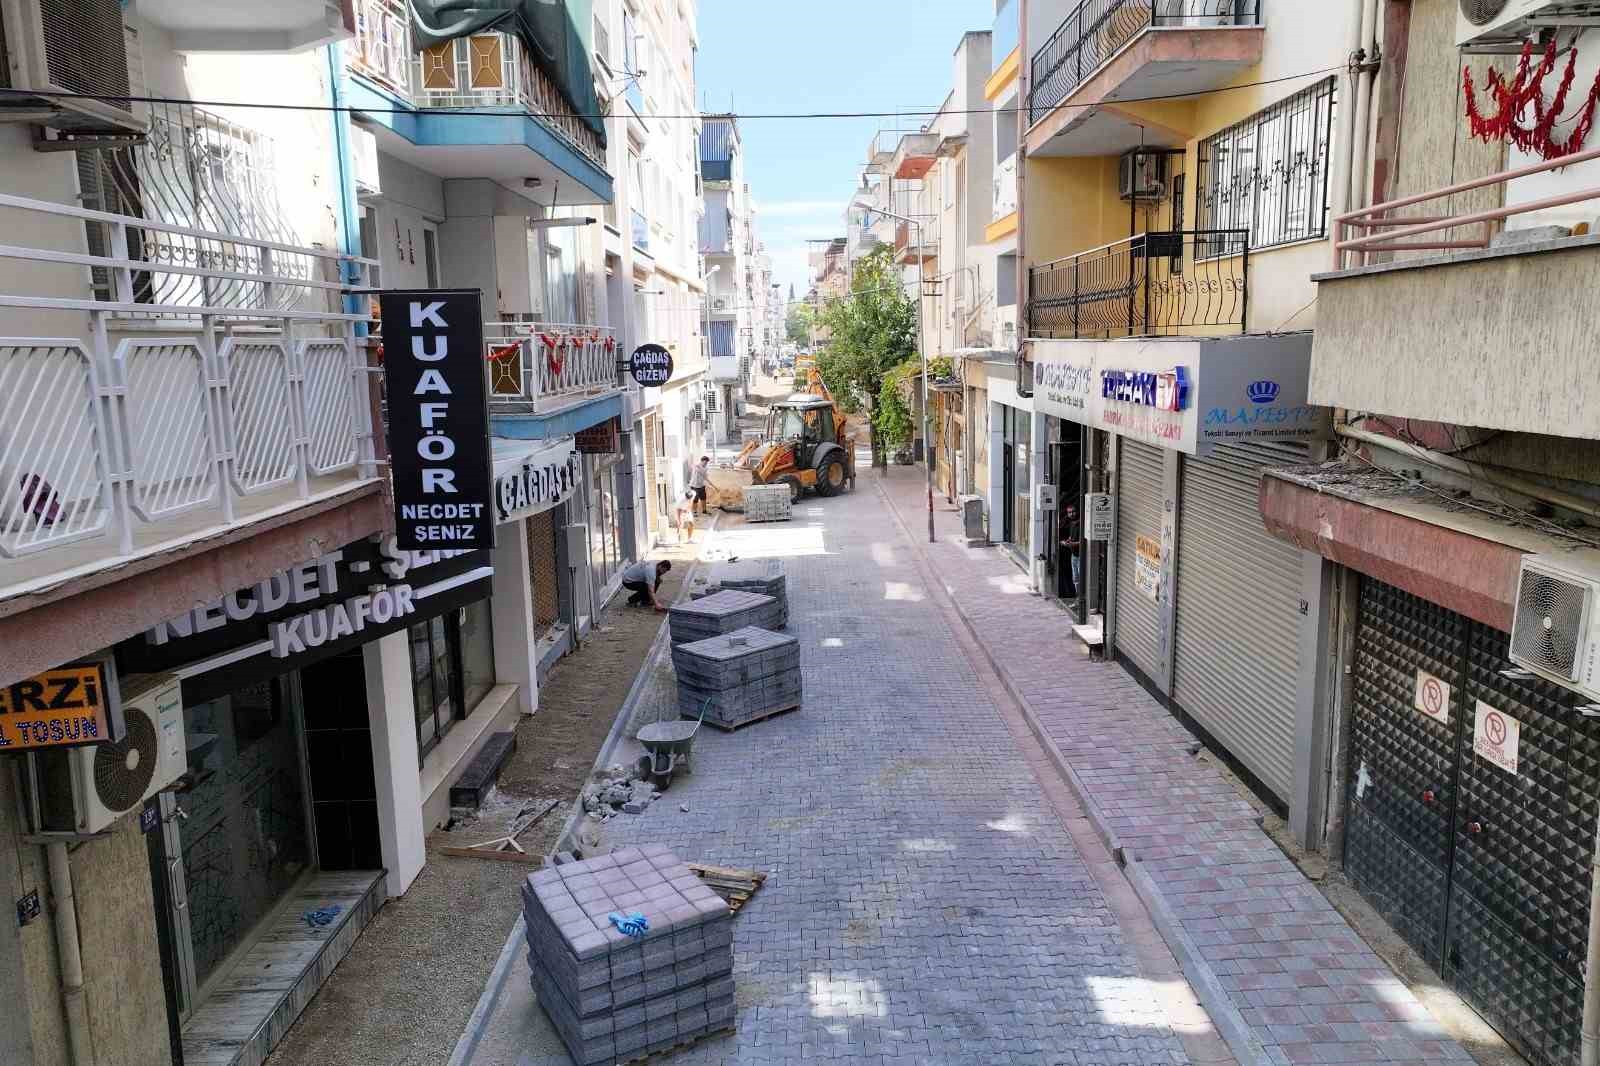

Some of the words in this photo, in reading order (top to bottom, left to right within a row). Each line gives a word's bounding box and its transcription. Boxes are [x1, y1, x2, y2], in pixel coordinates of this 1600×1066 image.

[633, 350, 669, 367] ÇAĞDAŞ
[408, 301, 459, 494] KUAFÖR
[402, 504, 484, 519] NECDET
[268, 583, 416, 658] KUAFÖR
[16, 717, 97, 745] TOSUN
